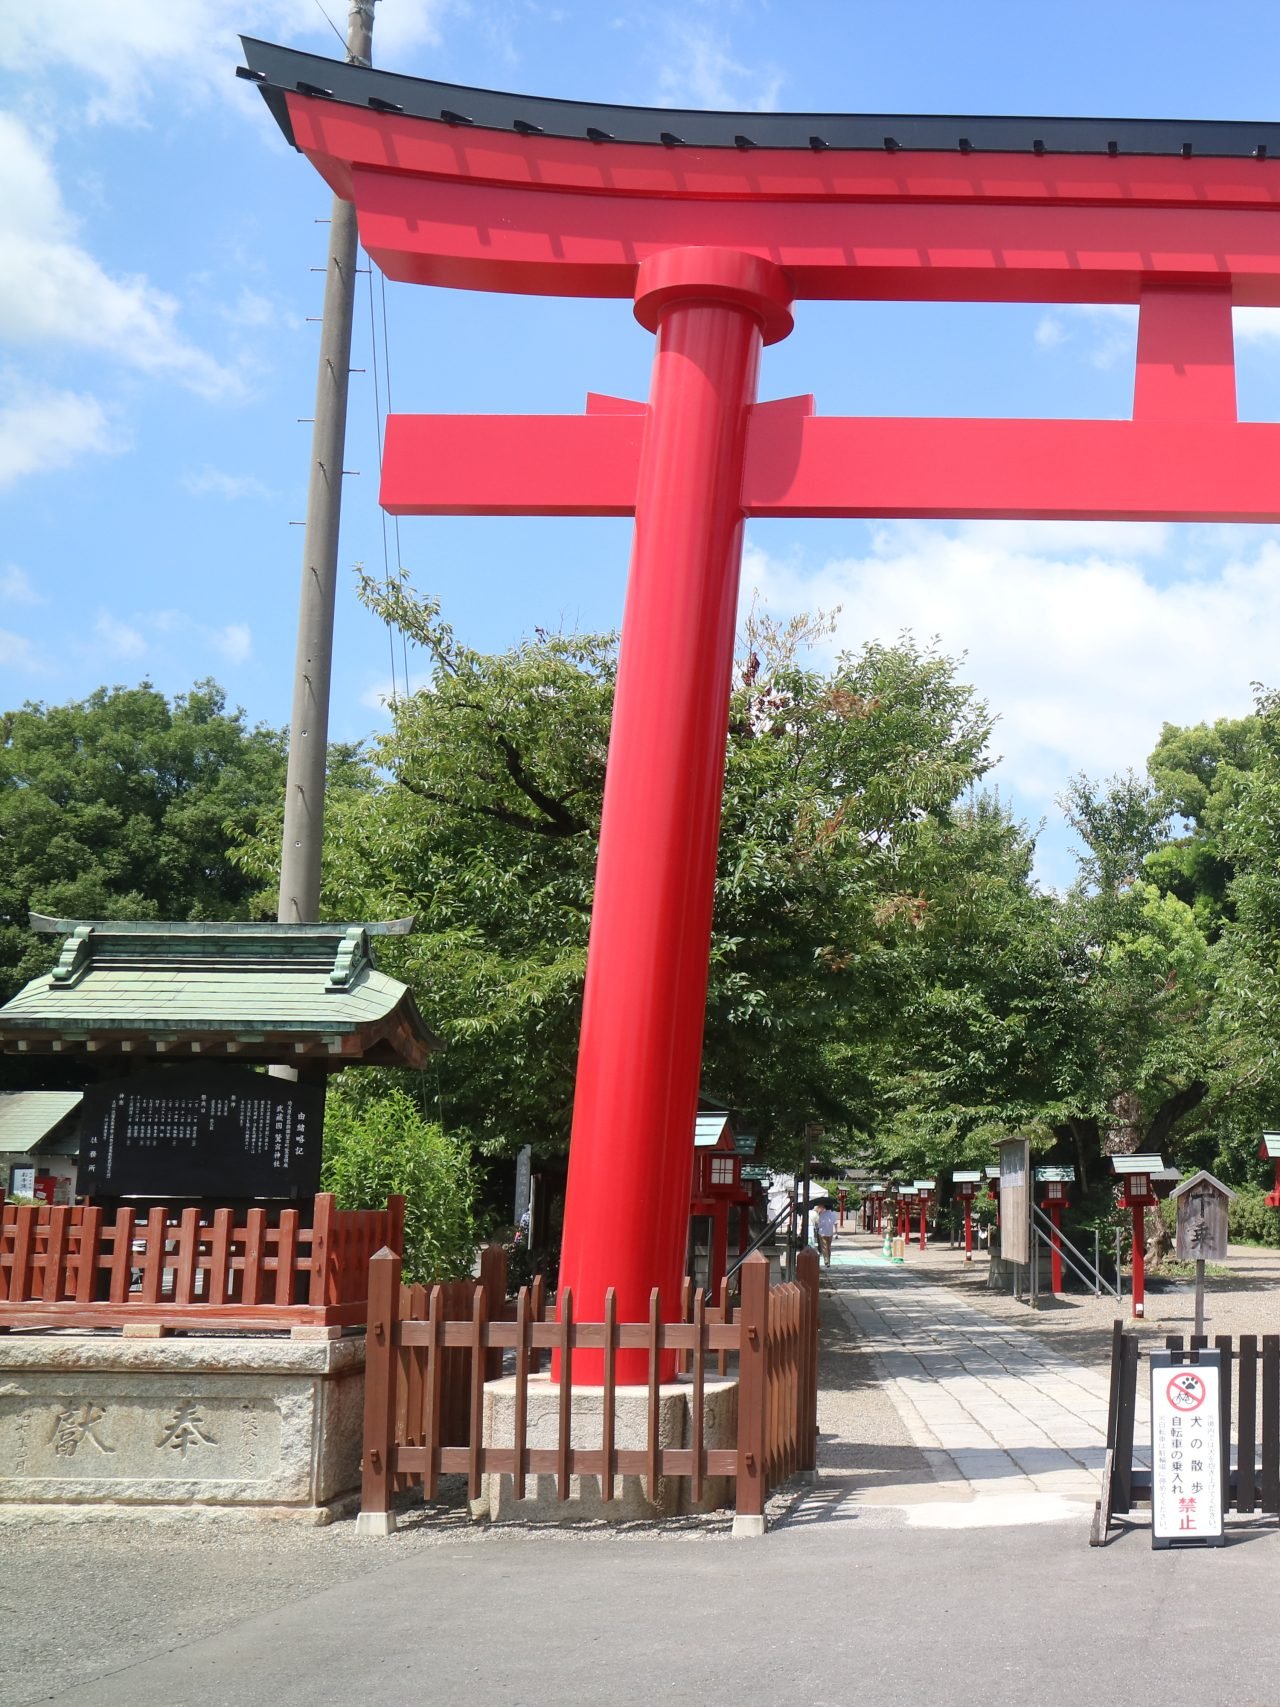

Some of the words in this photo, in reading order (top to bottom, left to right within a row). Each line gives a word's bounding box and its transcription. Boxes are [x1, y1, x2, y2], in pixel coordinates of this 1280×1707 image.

[294, 1112, 306, 1156] 由緒略記
[1171, 1416, 1184, 1495] 自転車の乗入れ
[1190, 1416, 1204, 1494] 犬の散歩
[1178, 1497, 1197, 1530] 禁止
